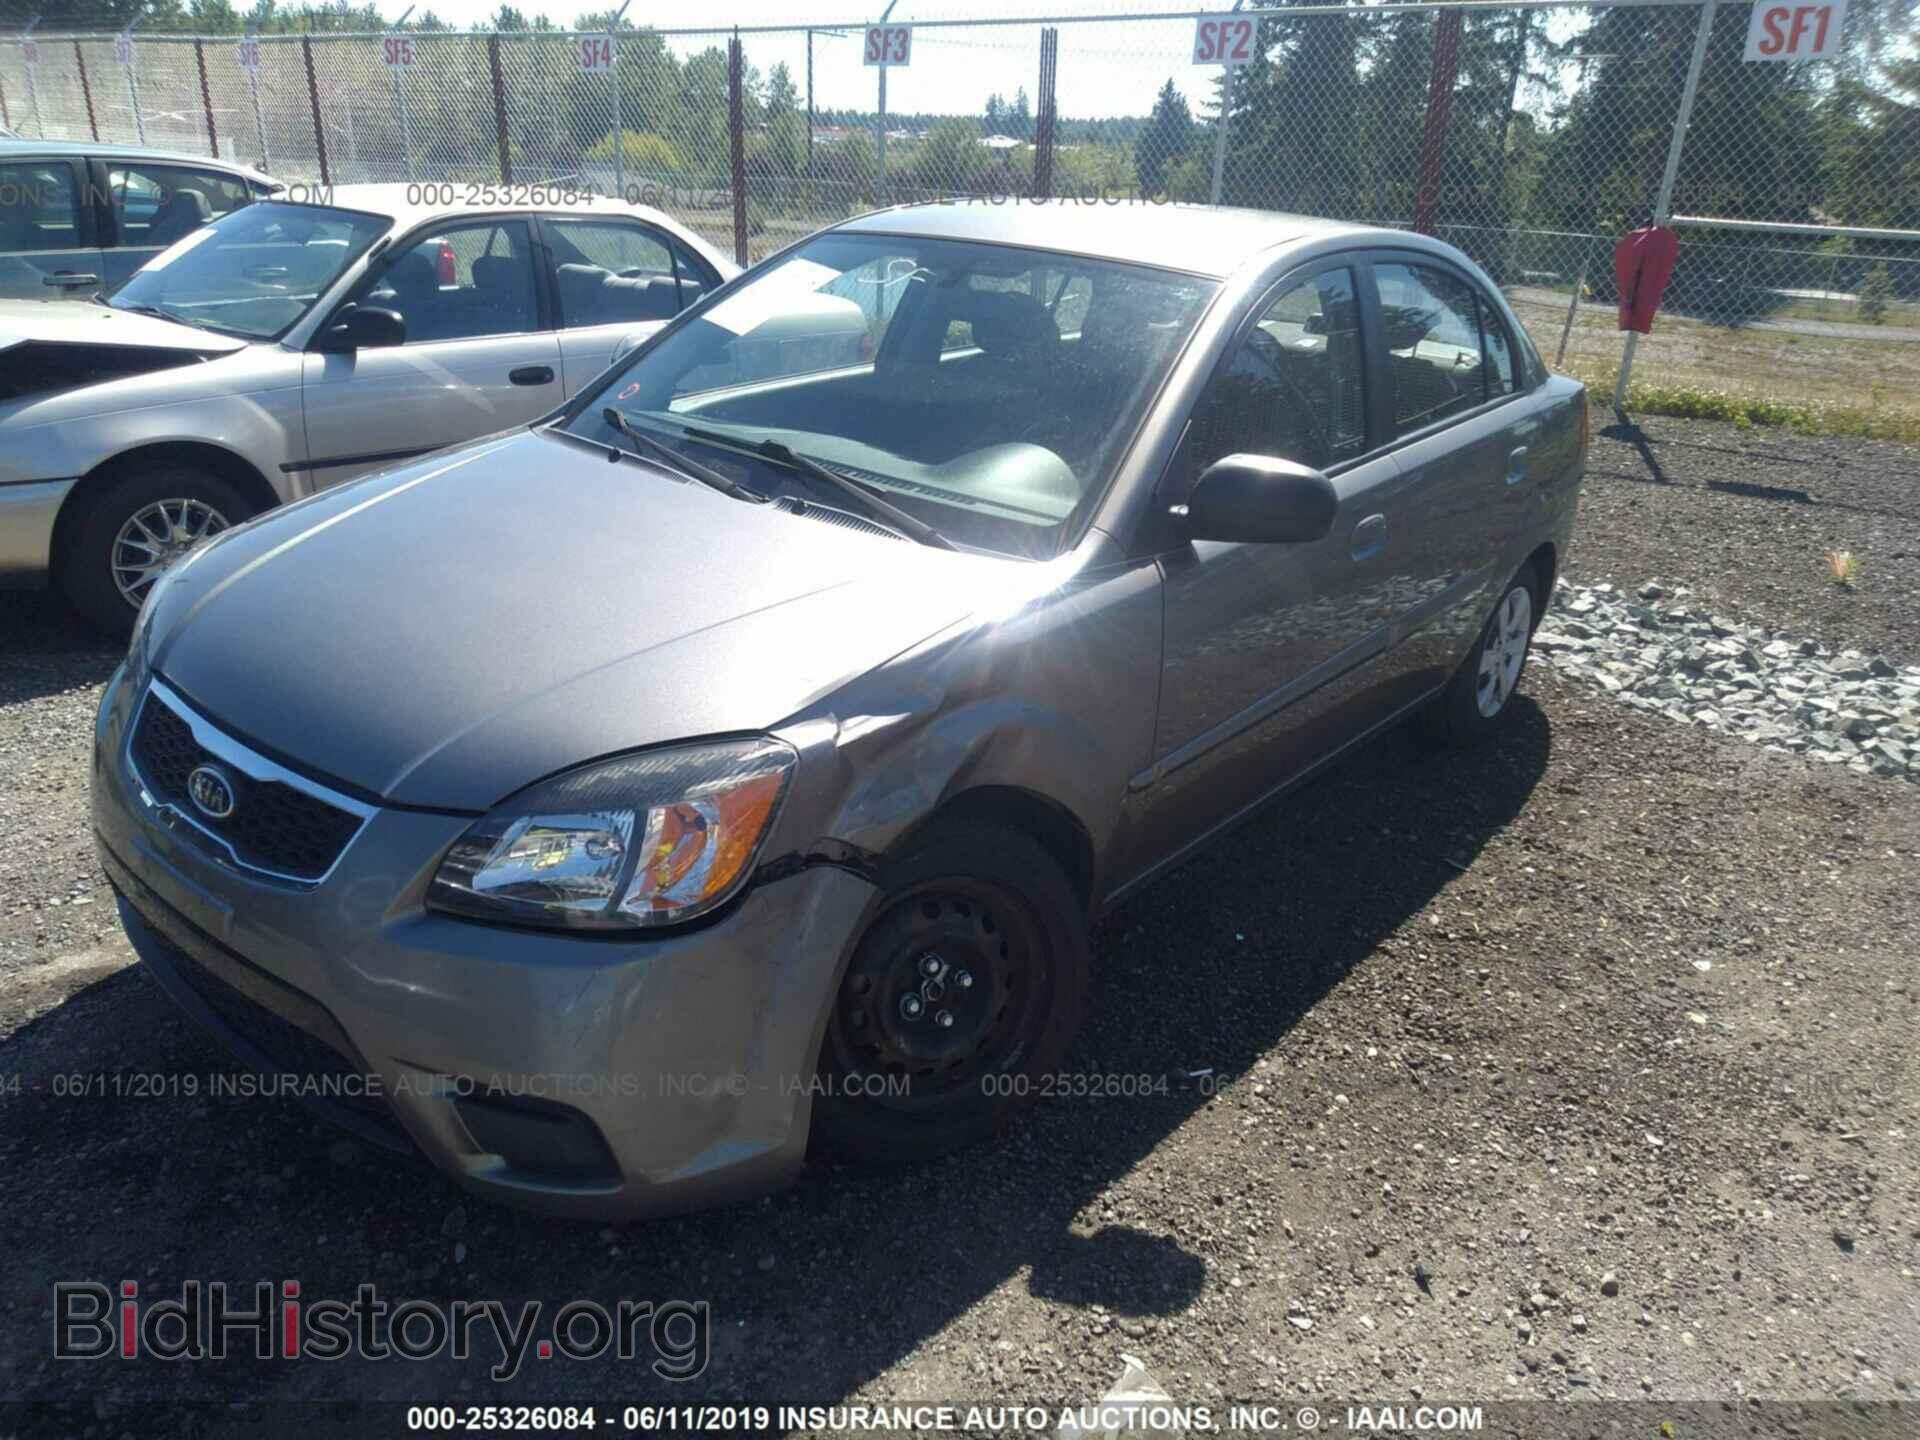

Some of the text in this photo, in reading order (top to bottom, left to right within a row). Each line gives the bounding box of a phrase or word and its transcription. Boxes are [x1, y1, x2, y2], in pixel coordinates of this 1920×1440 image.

[868, 28, 908, 61] SF3
[1199, 21, 1251, 60] SF2
[1759, 6, 1831, 55] SF1
[384, 38, 411, 65] SF5
[582, 39, 611, 68] SF4
